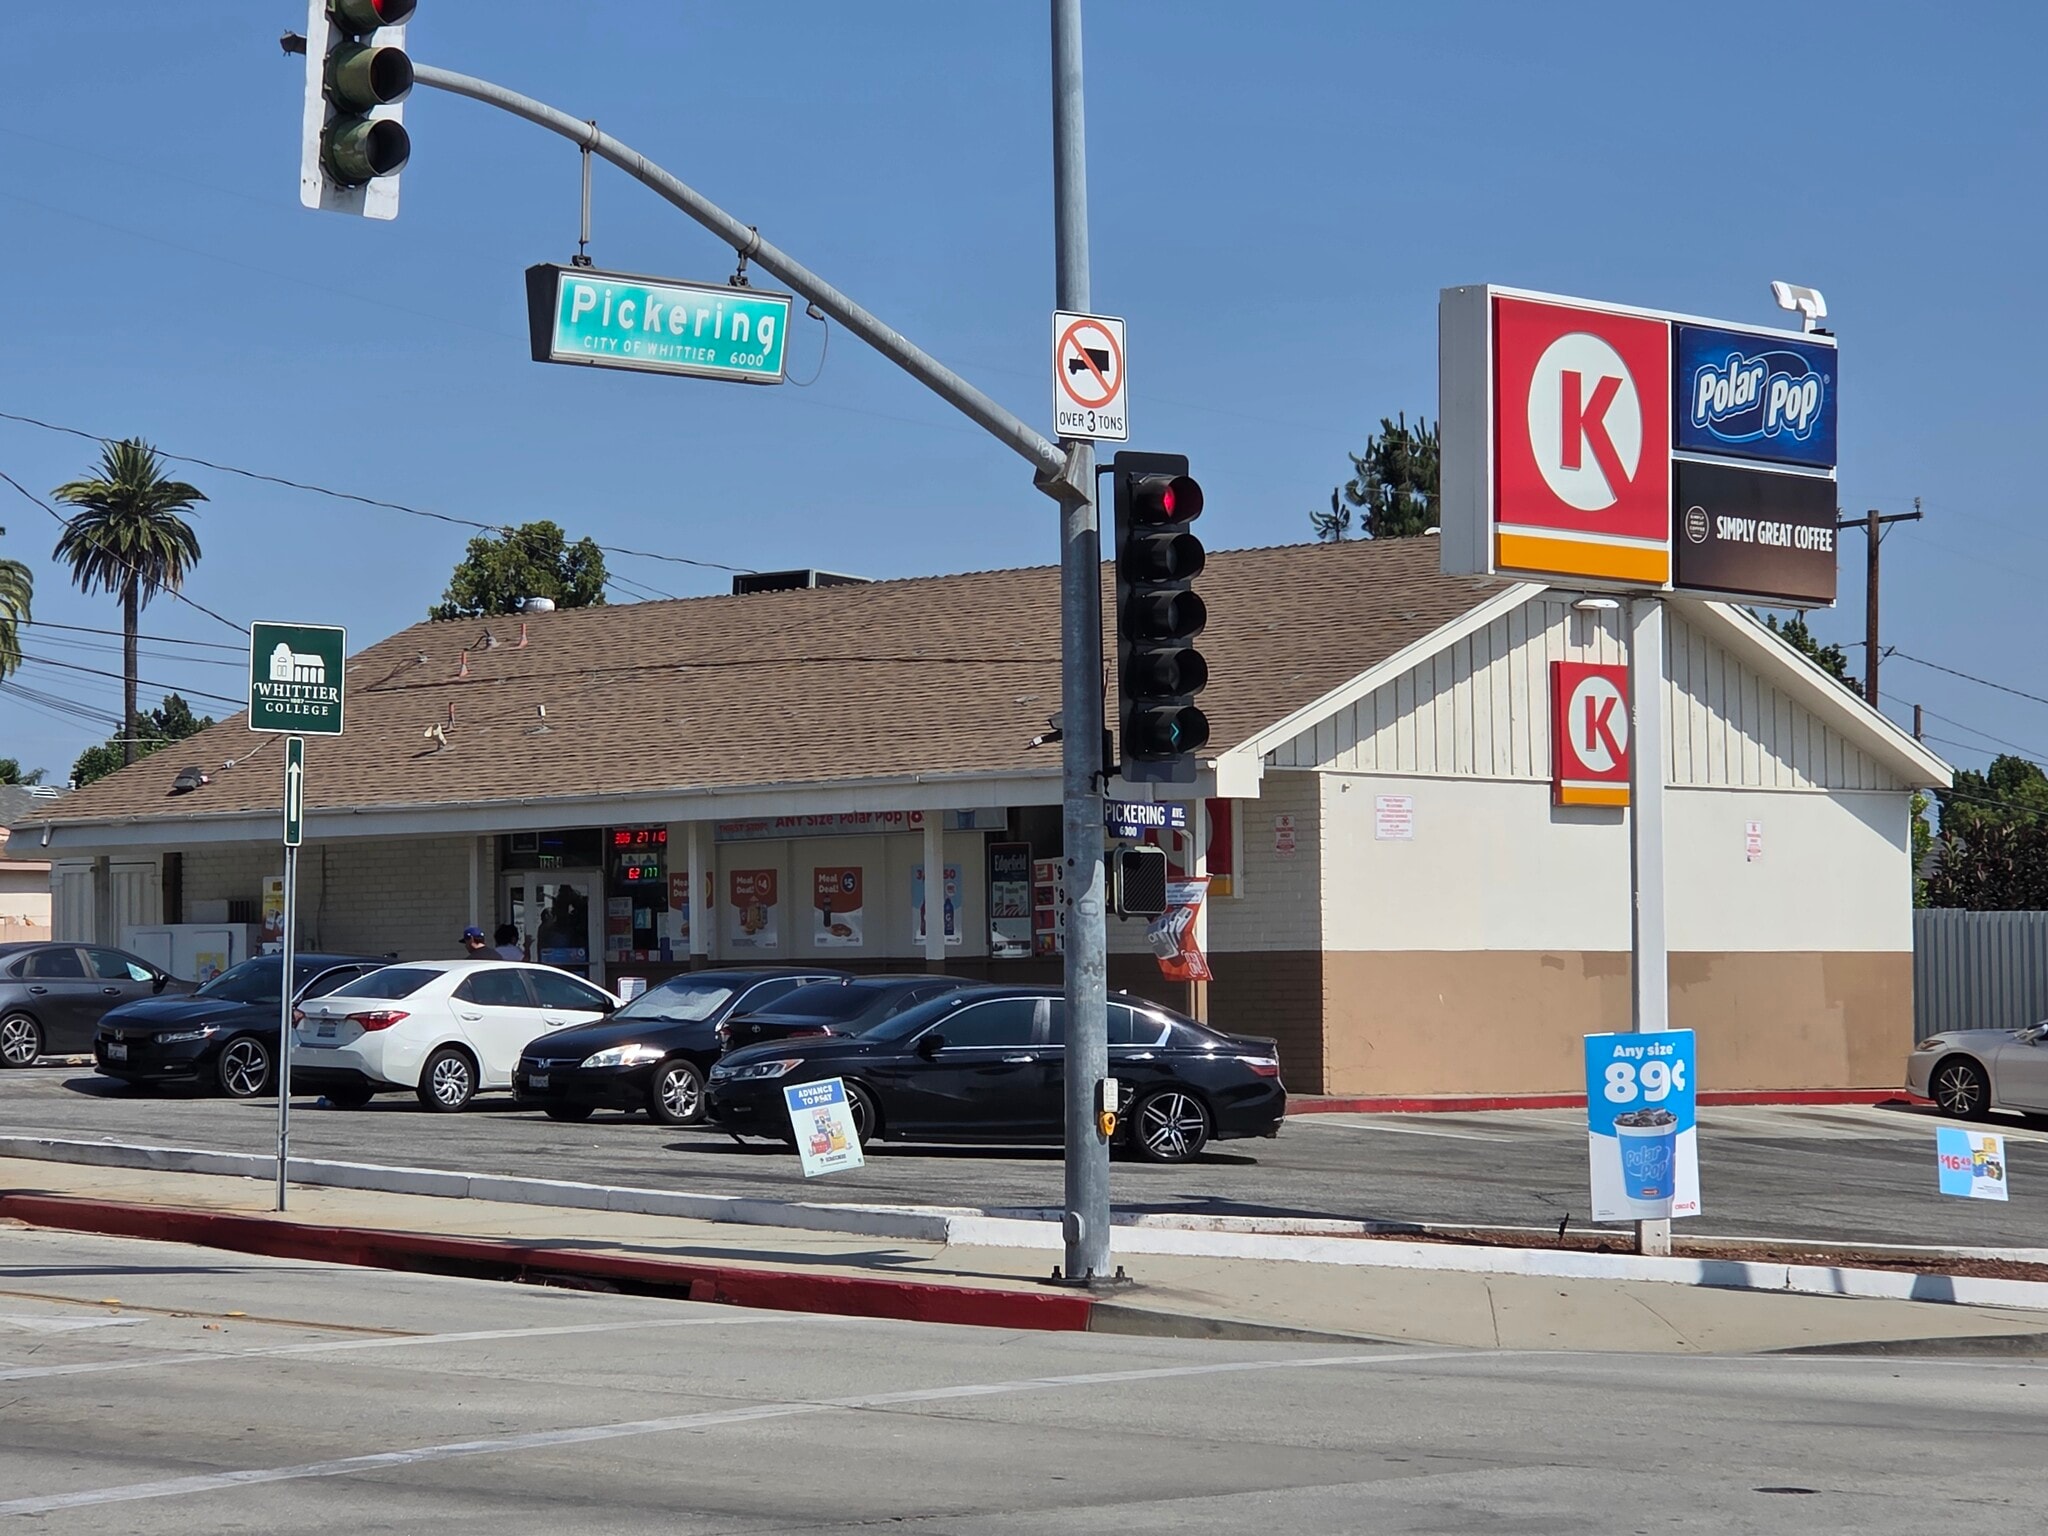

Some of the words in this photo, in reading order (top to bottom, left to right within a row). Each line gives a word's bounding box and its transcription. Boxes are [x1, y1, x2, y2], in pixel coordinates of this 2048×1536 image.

[571, 285, 775, 356] Pickering
[584, 335, 618, 349] CITY
[624, 340, 641, 352] OF
[648, 342, 716, 362] WHITTIER
[730, 351, 764, 367] 6000
[1697, 360, 1763, 419] Polar
[1768, 378, 1819, 430] Pop
[1060, 411, 1084, 427] OVER
[1087, 410, 1096, 432] 3
[1098, 415, 1123, 431] TONS
[1559, 368, 1632, 503] K
[1716, 516, 1756, 542] SIMPLY
[1757, 520, 1793, 546] GREAT
[1794, 524, 1833, 552] COFFEE
[253, 682, 340, 703] WHITTIER
[265, 702, 329, 716] COLLEGE
[1585, 695, 1623, 764] K
[1104, 803, 1166, 826] PICKERING
[673, 877, 689, 887] Mea
[736, 875, 753, 885] Meal
[818, 873, 838, 884] Meal
[673, 888, 689, 898] Dea
[1613, 1045, 1644, 1060] Any
[798, 1085, 833, 1098] ADVANCE
[1603, 1059, 1686, 1104] 89¢
[802, 1098, 814, 1106] TO
[1626, 1145, 1661, 1168] Polar
[1641, 1161, 1666, 1181] Pop
